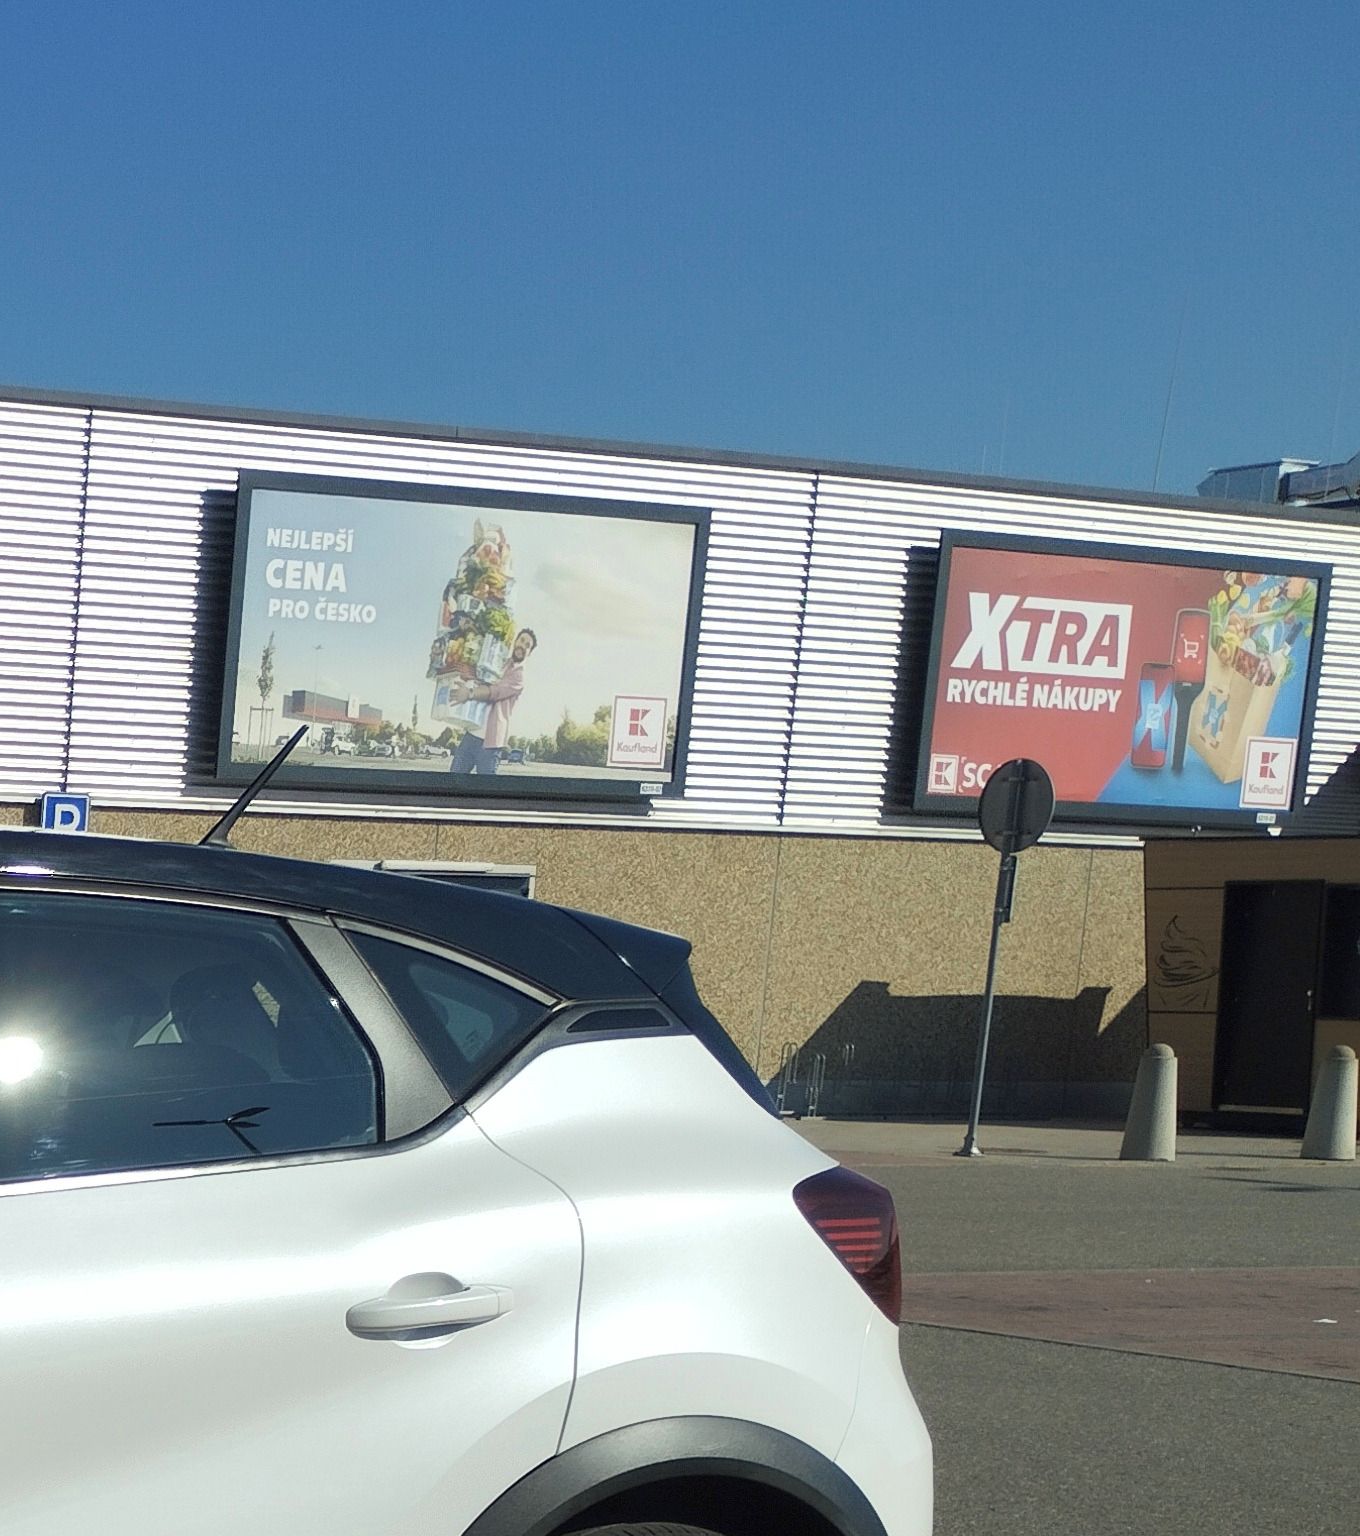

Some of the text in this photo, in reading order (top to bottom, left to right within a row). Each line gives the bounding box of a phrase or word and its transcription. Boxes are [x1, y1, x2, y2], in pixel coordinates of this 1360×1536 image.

[266, 527, 354, 553] NEJLEPŠÍ
[265, 558, 347, 593] CENA
[267, 597, 377, 625] PRO ČESKO
[950, 591, 1129, 677] XTRA
[946, 677, 1122, 713] RYCHLÉ NÁKUPY
[616, 741, 658, 754] Kaufland
